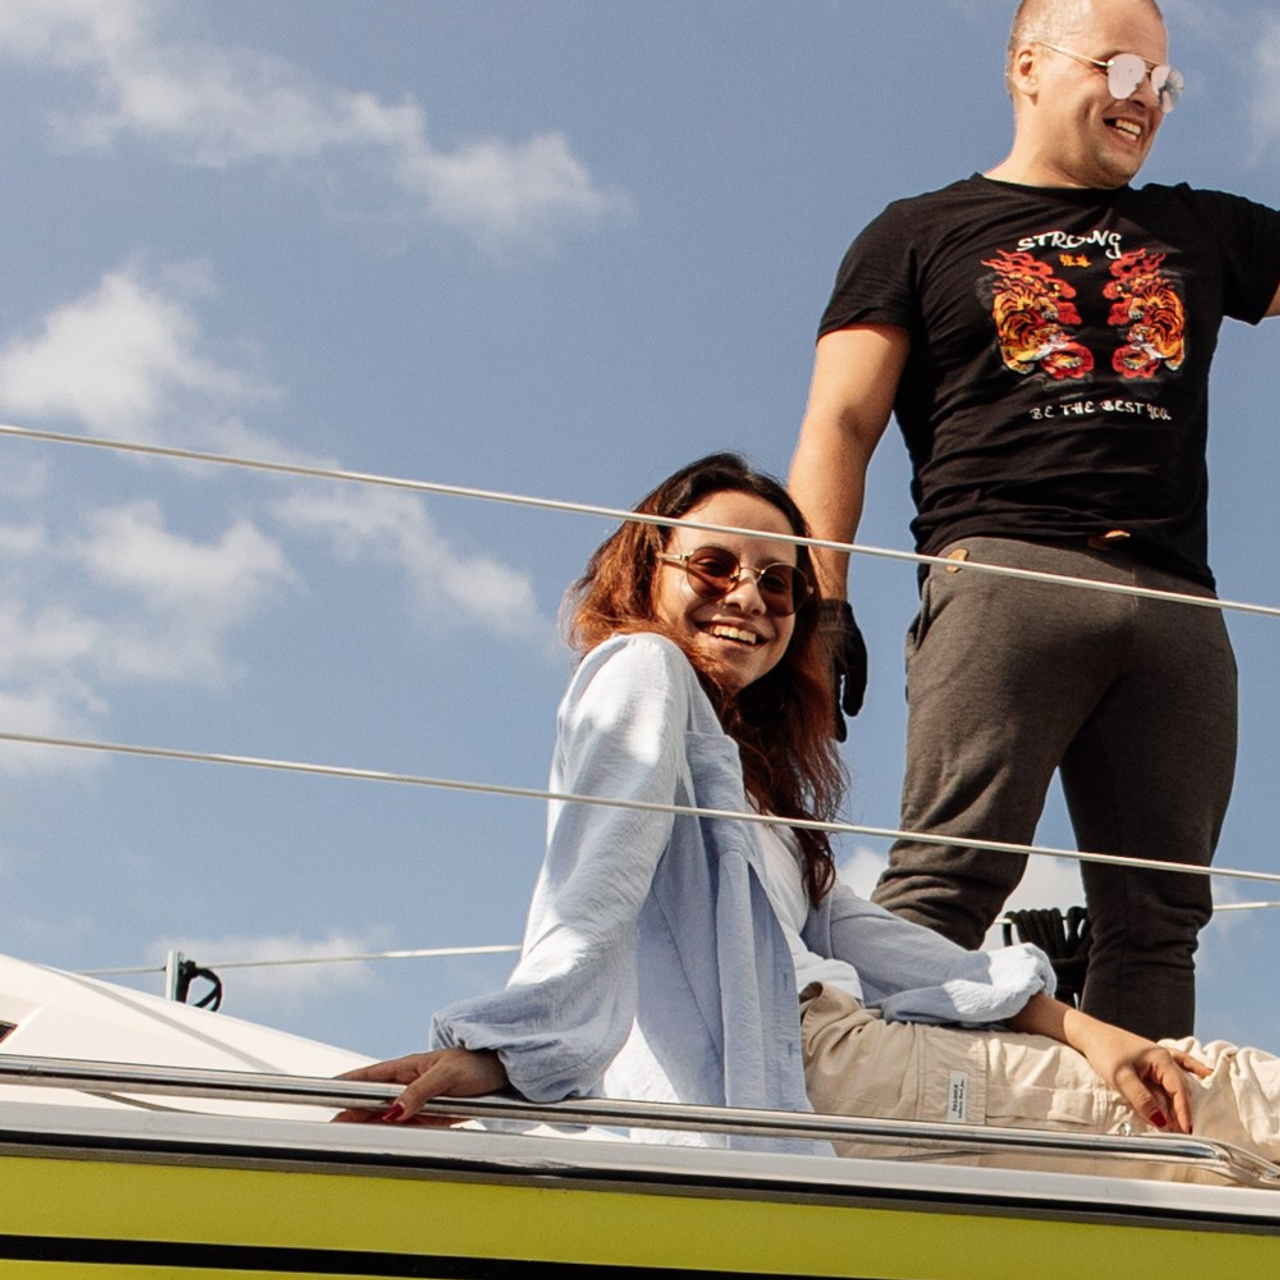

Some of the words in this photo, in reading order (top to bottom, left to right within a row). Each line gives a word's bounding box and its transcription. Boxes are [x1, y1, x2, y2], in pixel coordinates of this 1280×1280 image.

[1016, 230, 1122, 259] STRONG
[1030, 406, 1054, 420] BE
[1060, 401, 1095, 416] THE
[1100, 400, 1145, 414] BEST
